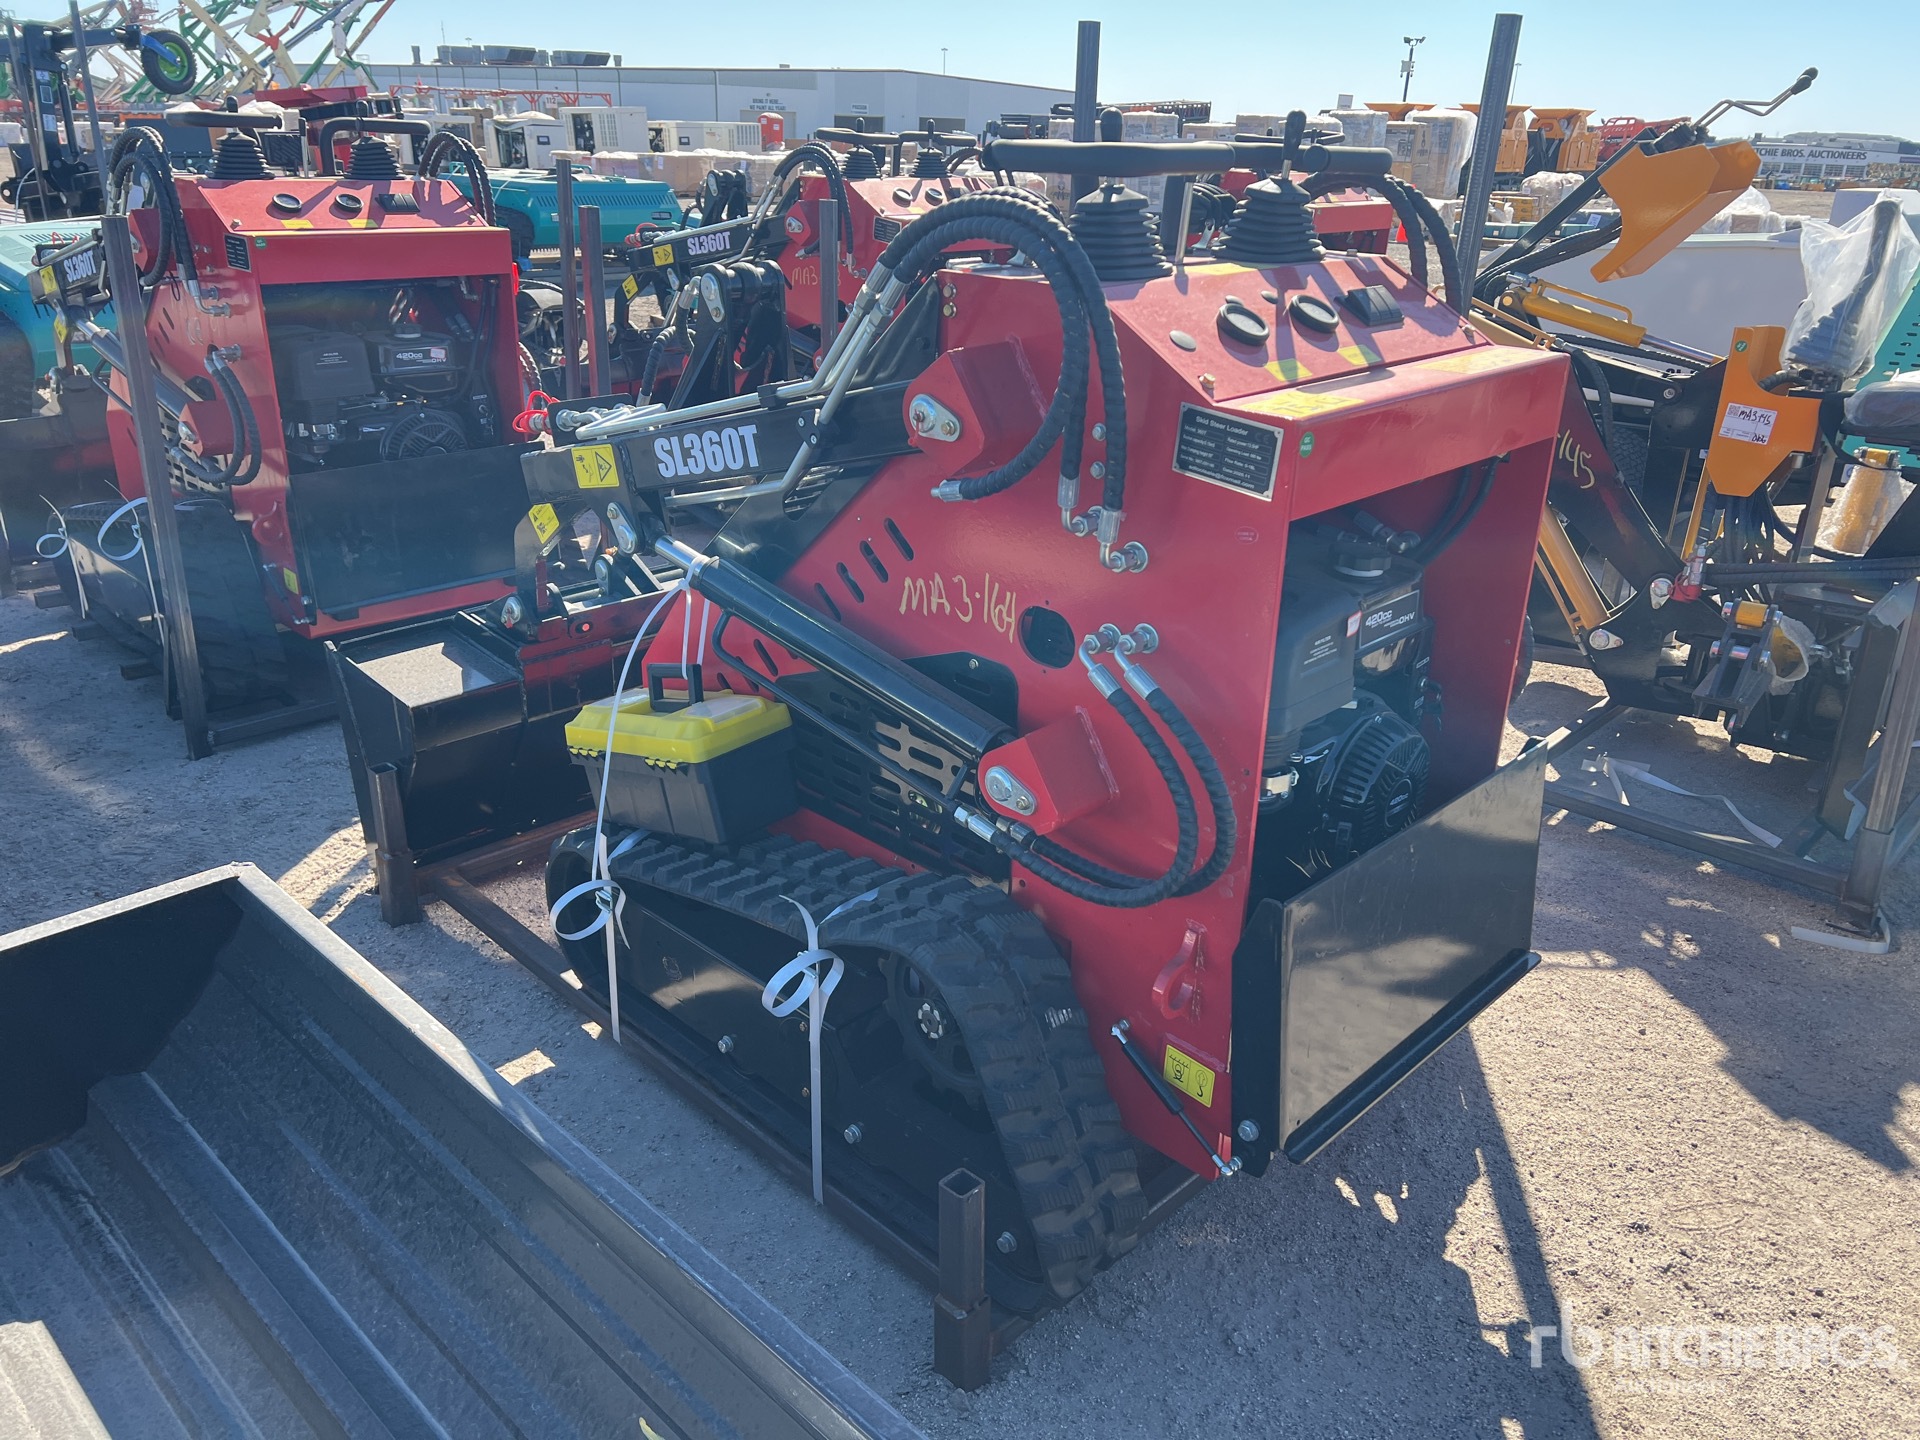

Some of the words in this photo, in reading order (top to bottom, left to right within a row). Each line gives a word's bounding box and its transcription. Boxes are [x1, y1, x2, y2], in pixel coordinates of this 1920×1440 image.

[1754, 148, 1779, 156] TCHIE
[1781, 148, 1805, 158] BROS.
[1808, 150, 1868, 160] AUCTIONEERS
[687, 232, 730, 256] SL360T
[64, 250, 96, 282] SL360T
[1195, 415, 1208, 425] Skid
[1209, 419, 1226, 430] Steer
[1226, 424, 1248, 436] Loader
[654, 424, 759, 478] SL360T
[1366, 610, 1392, 626] 420cc
[1400, 612, 1415, 624] OHV
